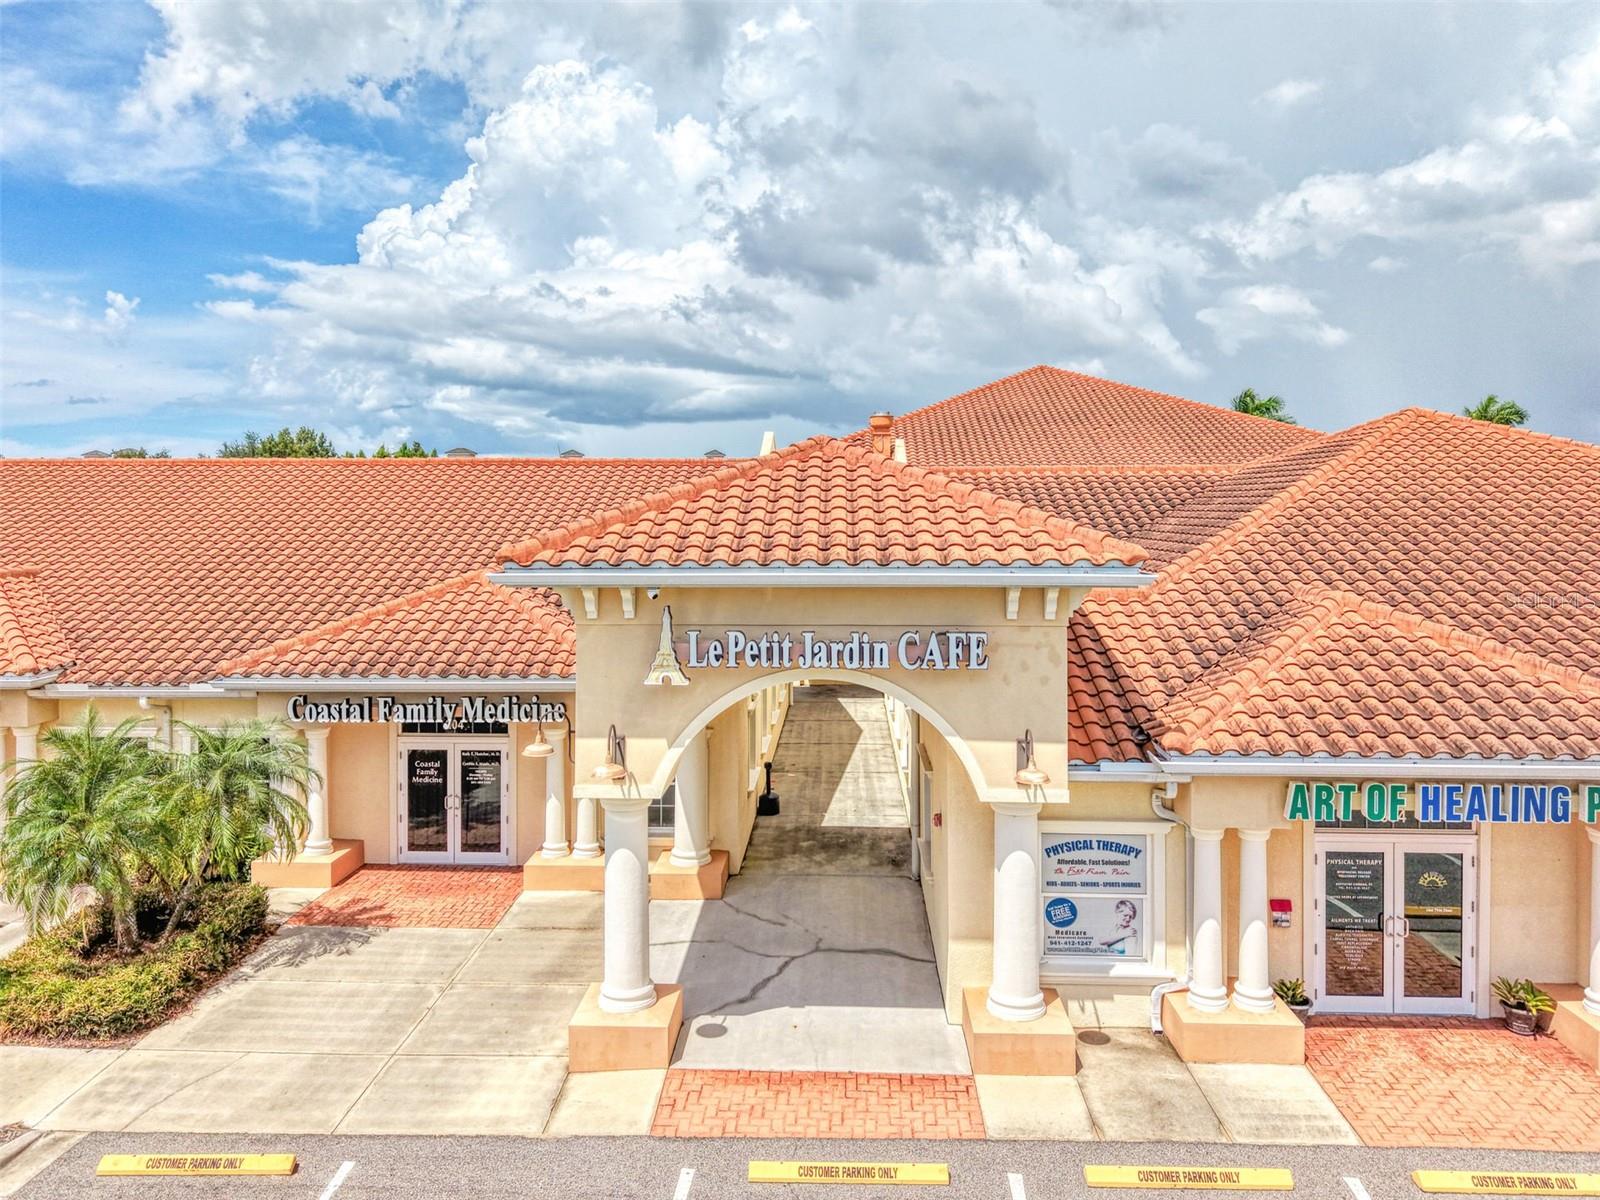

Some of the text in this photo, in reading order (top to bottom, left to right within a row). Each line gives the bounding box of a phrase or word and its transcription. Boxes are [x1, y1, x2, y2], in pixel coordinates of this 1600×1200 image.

[798, 630, 890, 670] Jardin
[897, 631, 990, 671] CAFE
[287, 694, 567, 730] Coastal Family Medicine
[414, 760, 441, 768] Coastal
[416, 768, 439, 776] Family
[411, 776, 443, 784] Medicine
[1284, 781, 1358, 822] ART
[1362, 781, 1408, 823] OF
[1414, 782, 1572, 824] HEALING
[1044, 840, 1142, 859] PHYSICAL THERAPY
[1089, 858, 1100, 866] Fast
[1050, 906, 1071, 920] FREE
[145, 1157, 245, 1169] CUSTOMER PARKING ONLY
[797, 1165, 899, 1179] CUSTOMER PARKING ONLY
[1137, 1170, 1241, 1184] CUSTOMER PARKING ONLY
[1471, 1175, 1578, 1190] CUSTOMER PARKING ONLY
